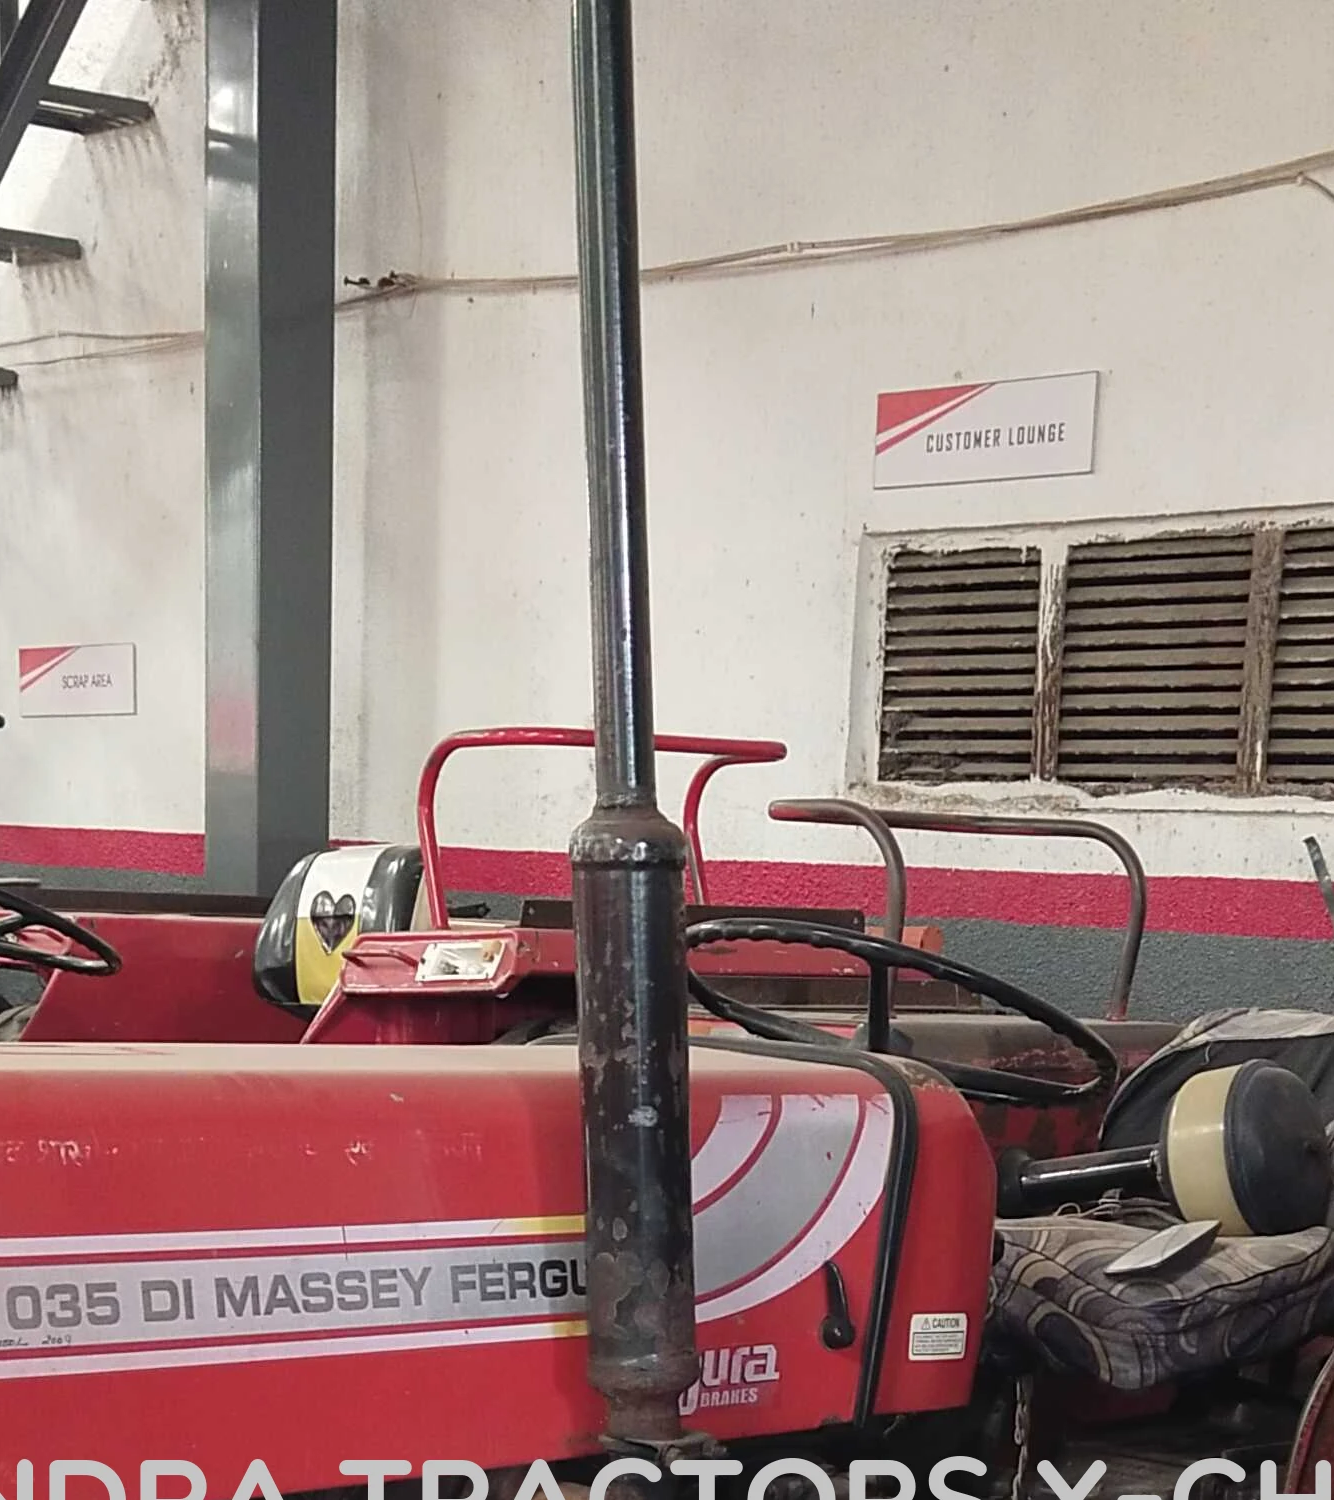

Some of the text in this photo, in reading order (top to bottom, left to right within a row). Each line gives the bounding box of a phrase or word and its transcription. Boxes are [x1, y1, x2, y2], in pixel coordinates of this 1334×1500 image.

[926, 422, 1065, 453] CUSTOMER LOUNGE
[61, 673, 112, 689] SCRAP AREA
[141, 1278, 195, 1323] DI
[213, 1266, 432, 1319] MASSEY
[699, 1386, 759, 1408] BRAKES
